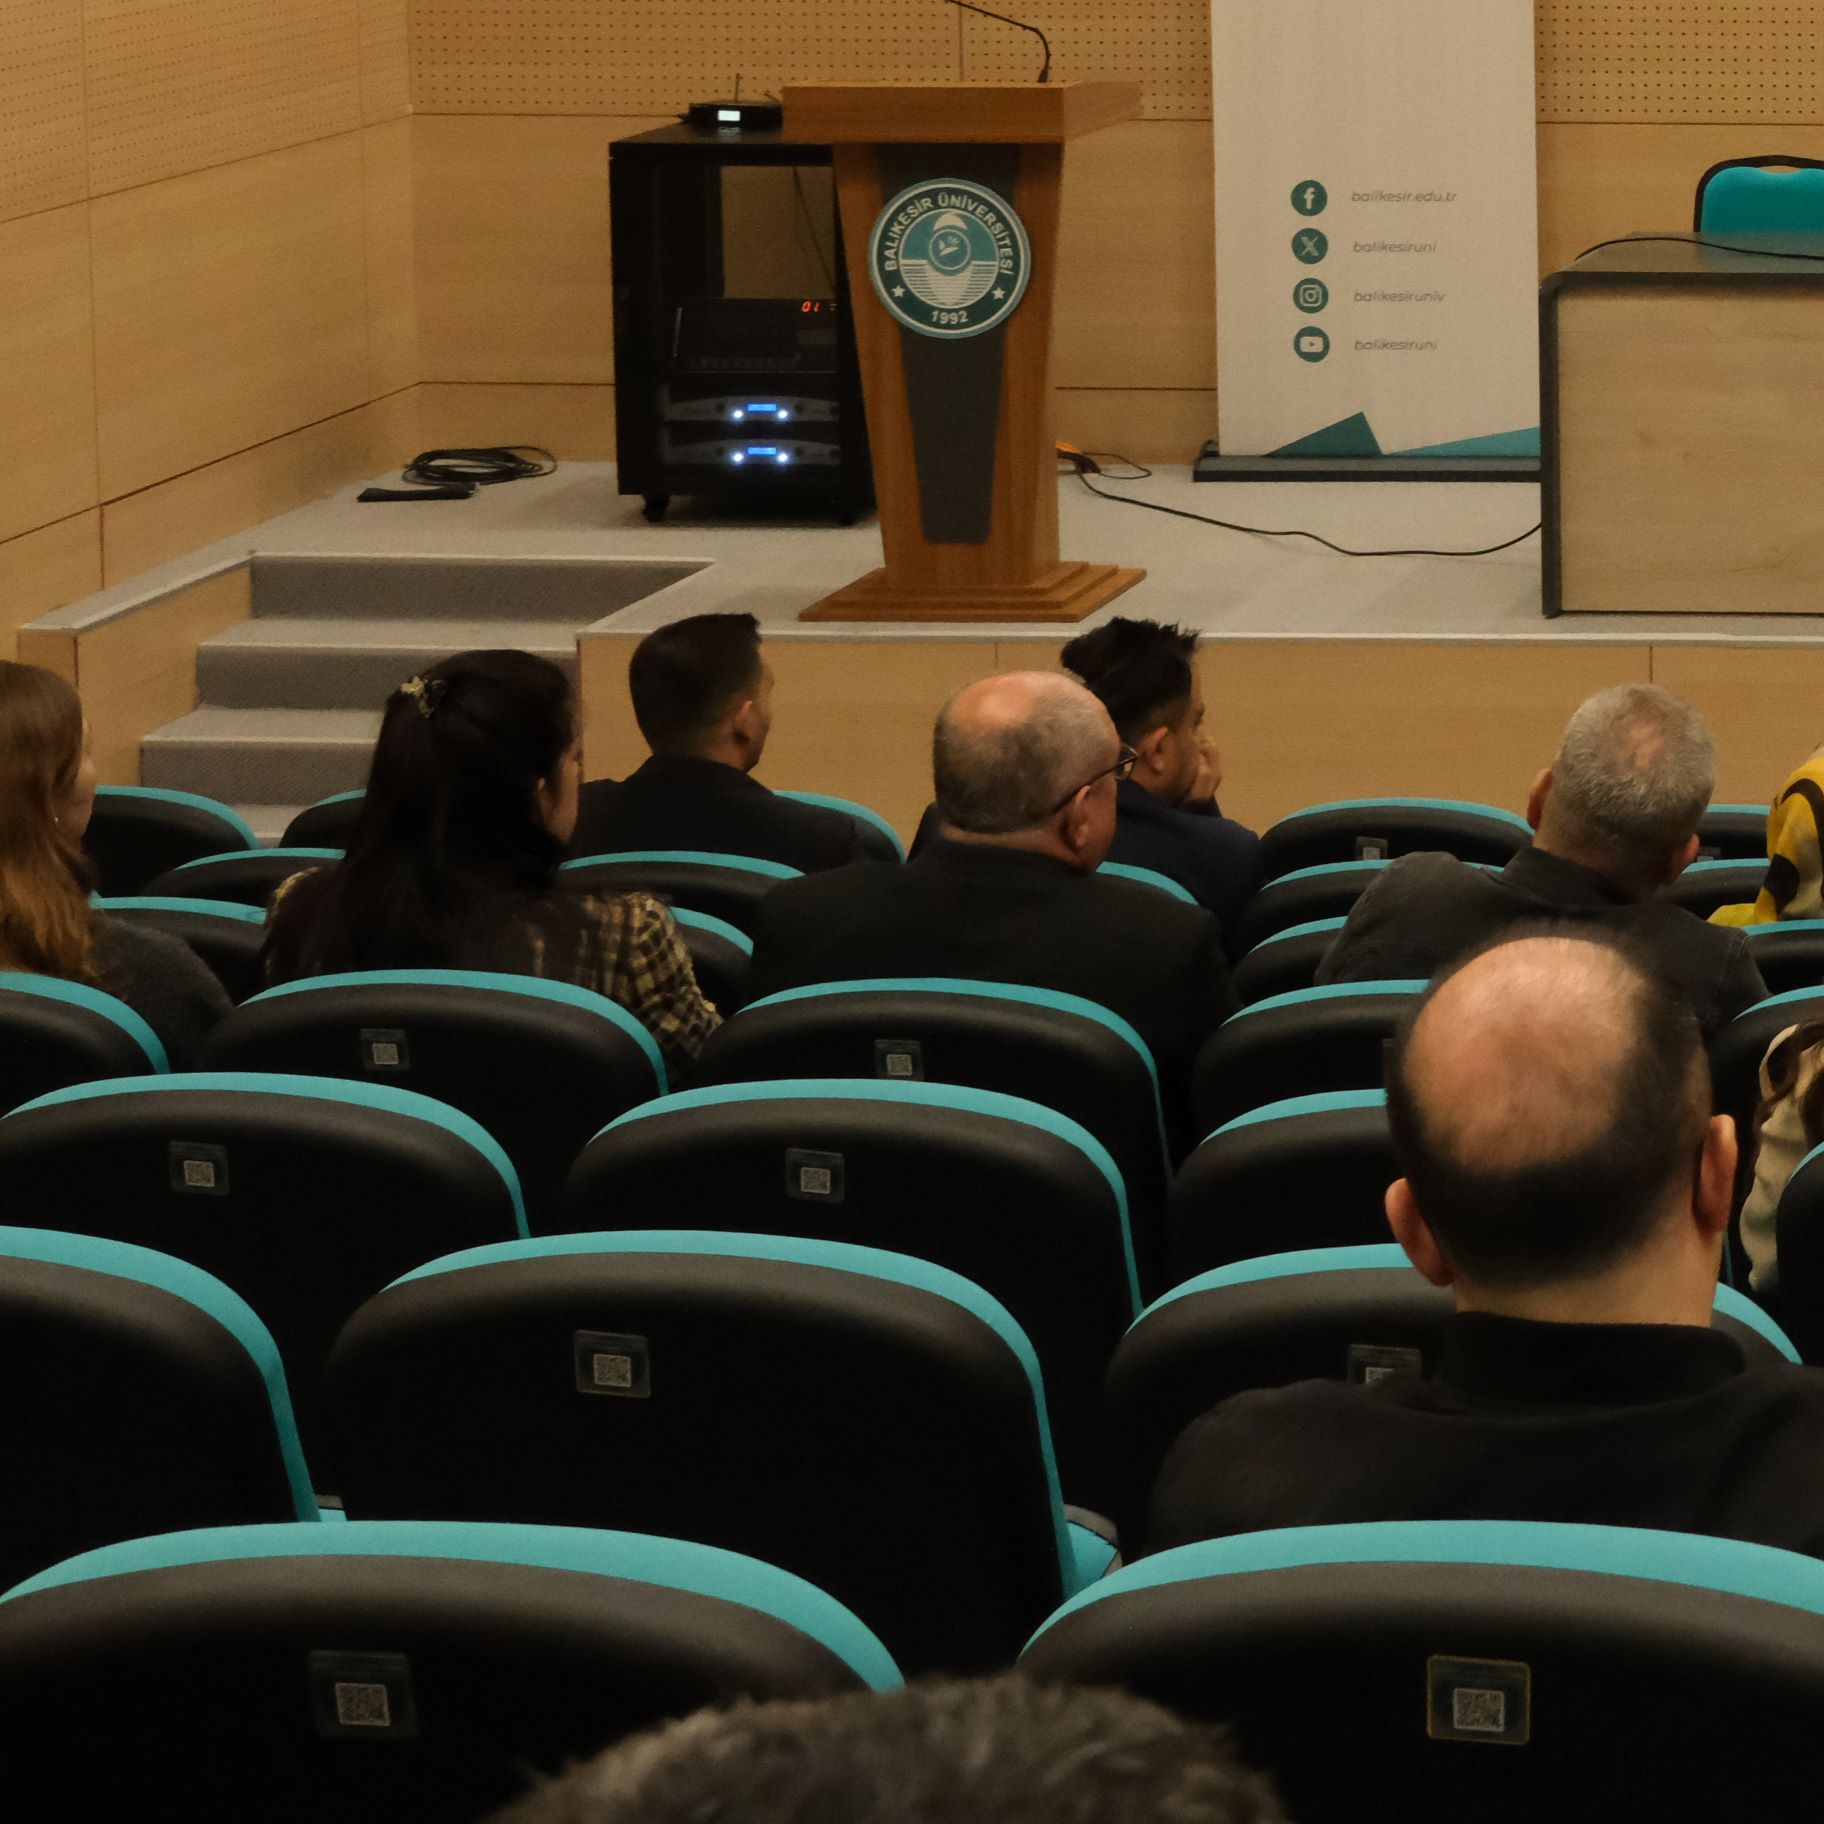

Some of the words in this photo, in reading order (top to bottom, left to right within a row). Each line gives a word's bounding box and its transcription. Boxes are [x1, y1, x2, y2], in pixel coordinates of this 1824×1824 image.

[884, 196, 934, 271] BALIKESİR
[937, 191, 1014, 275] ÜNİVERSİTESİ
[930, 309, 969, 325] 1992
